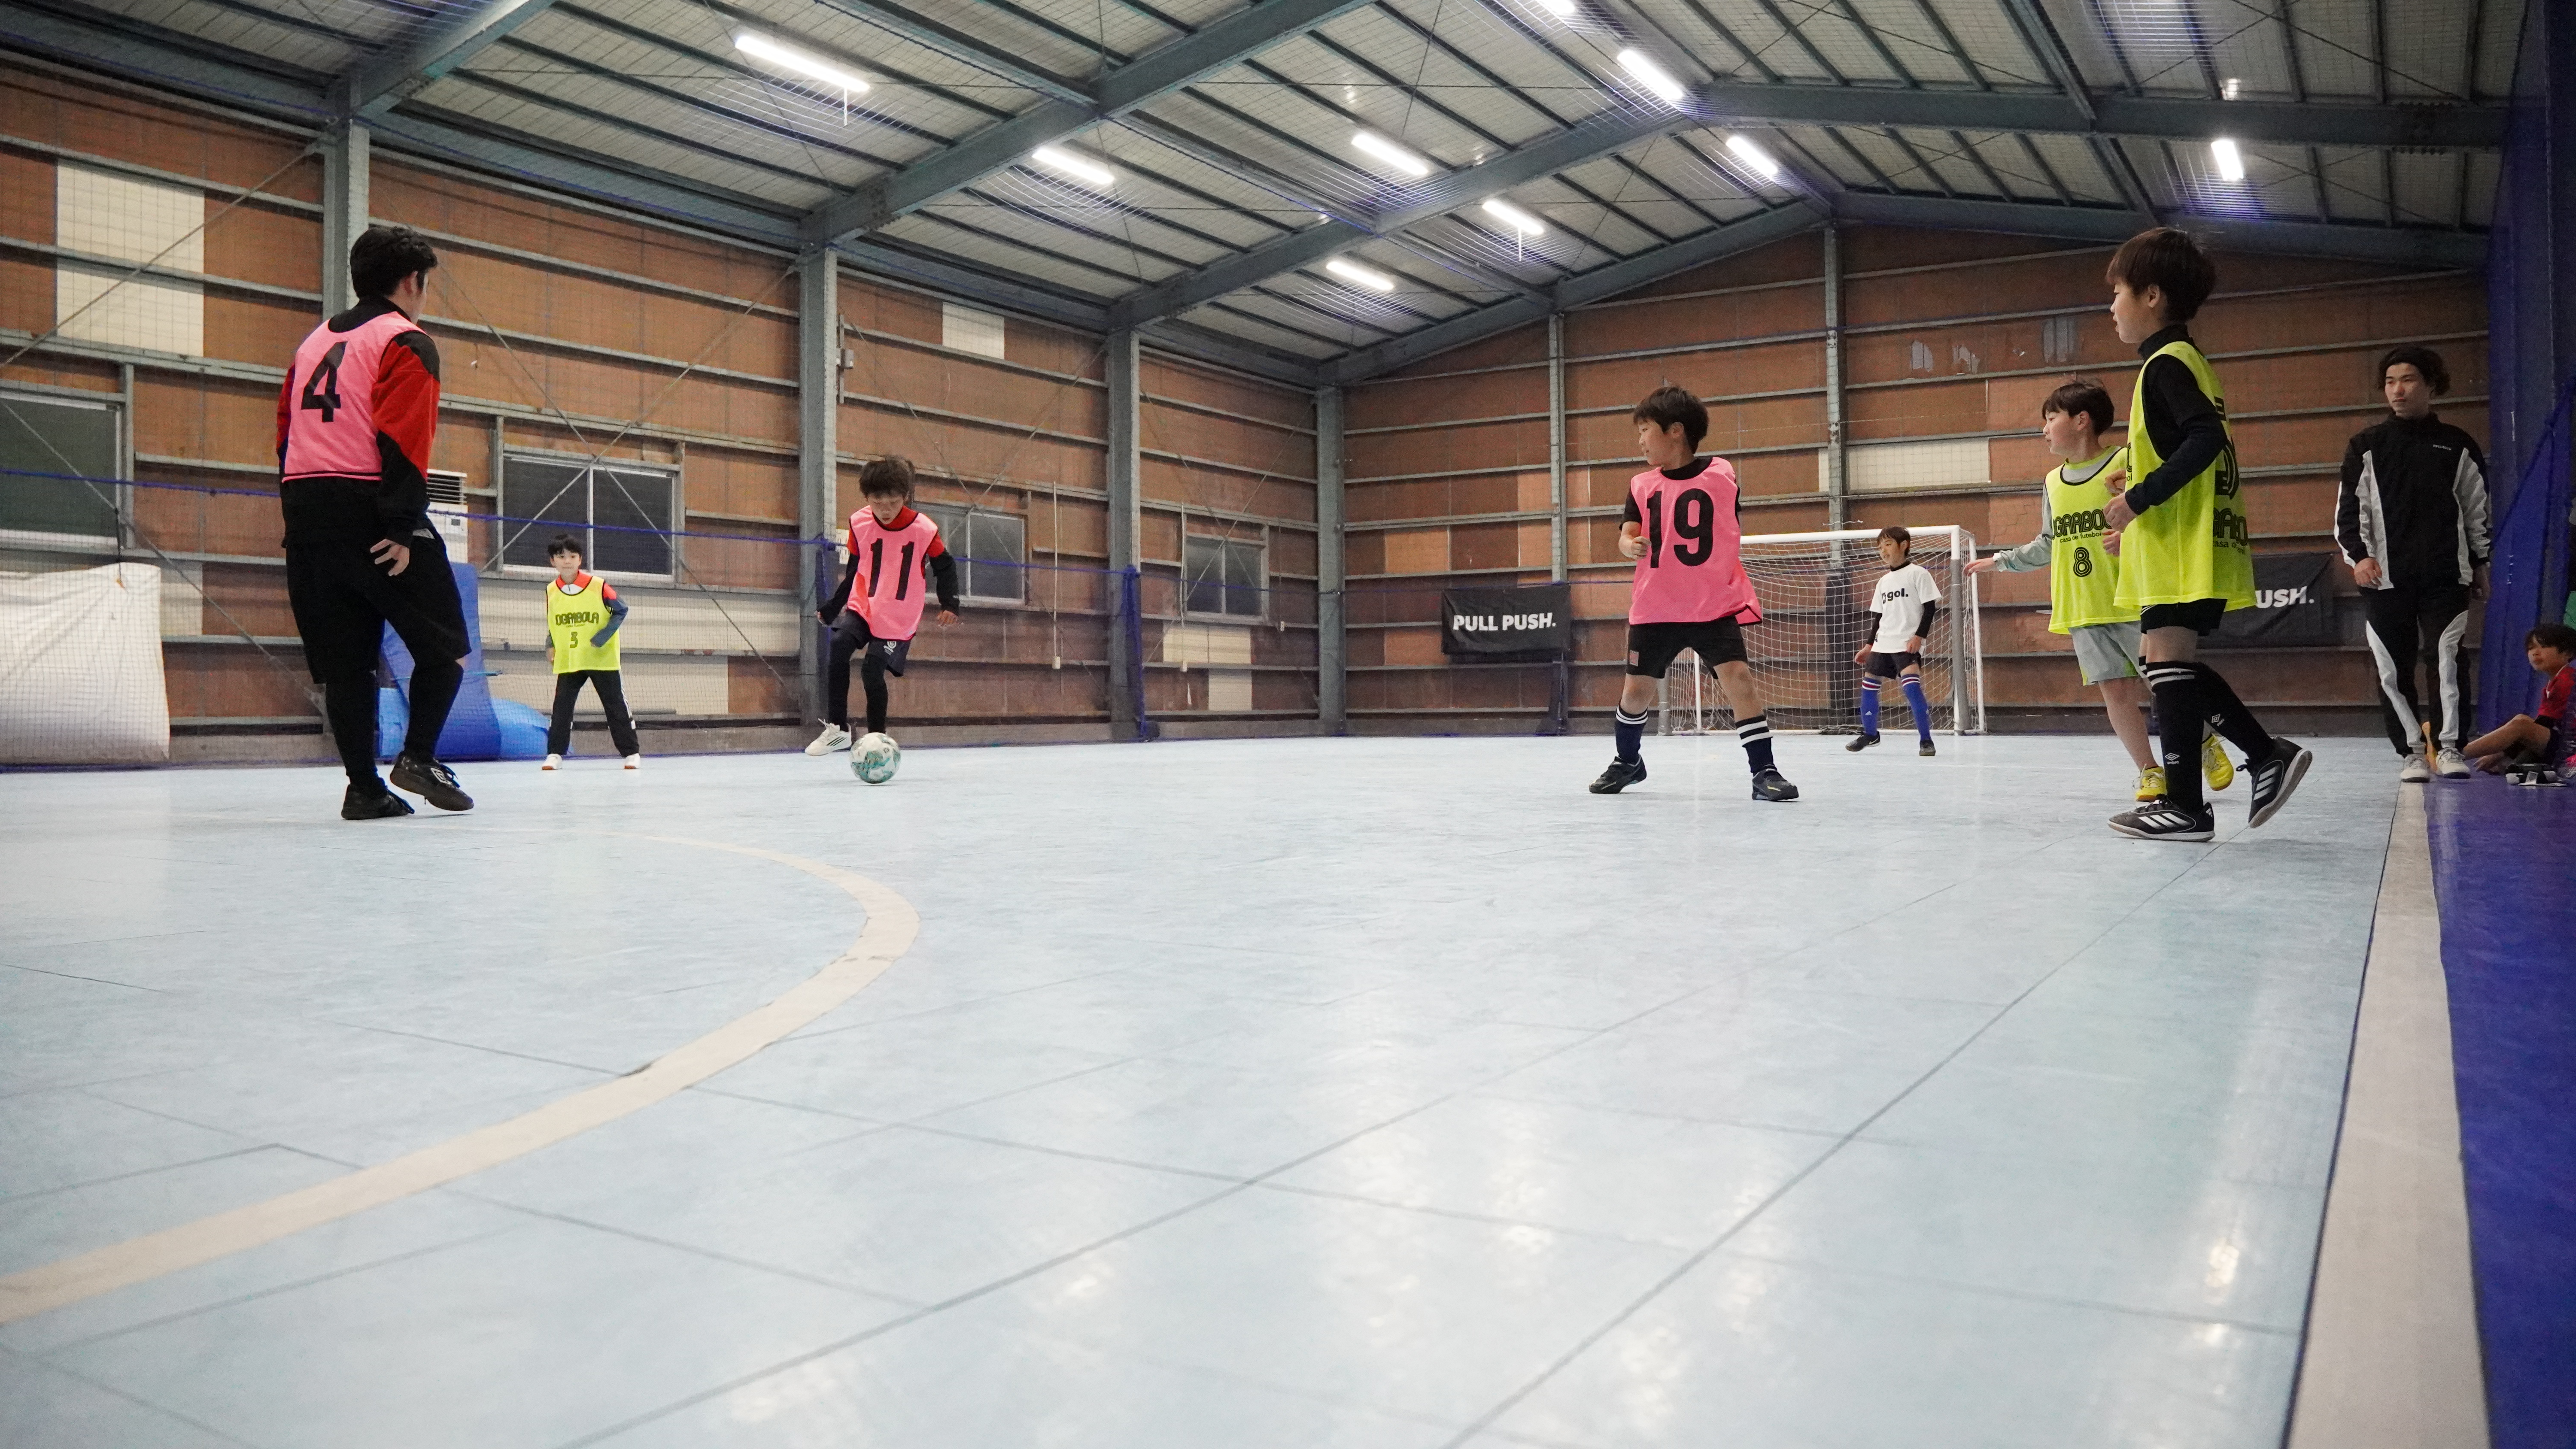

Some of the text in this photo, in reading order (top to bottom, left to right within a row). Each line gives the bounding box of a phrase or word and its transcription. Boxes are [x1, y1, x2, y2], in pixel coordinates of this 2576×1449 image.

[301, 341, 348, 423] 4
[1646, 488, 1714, 569] 19
[2080, 530, 2102, 539] futebol
[868, 538, 914, 601] 11
[2073, 547, 2093, 577] 8
[1887, 588, 1909, 601] gol.
[2255, 585, 2315, 609] USH.
[1453, 612, 1556, 631] PULL PUSH.
[569, 631, 578, 648] 3
